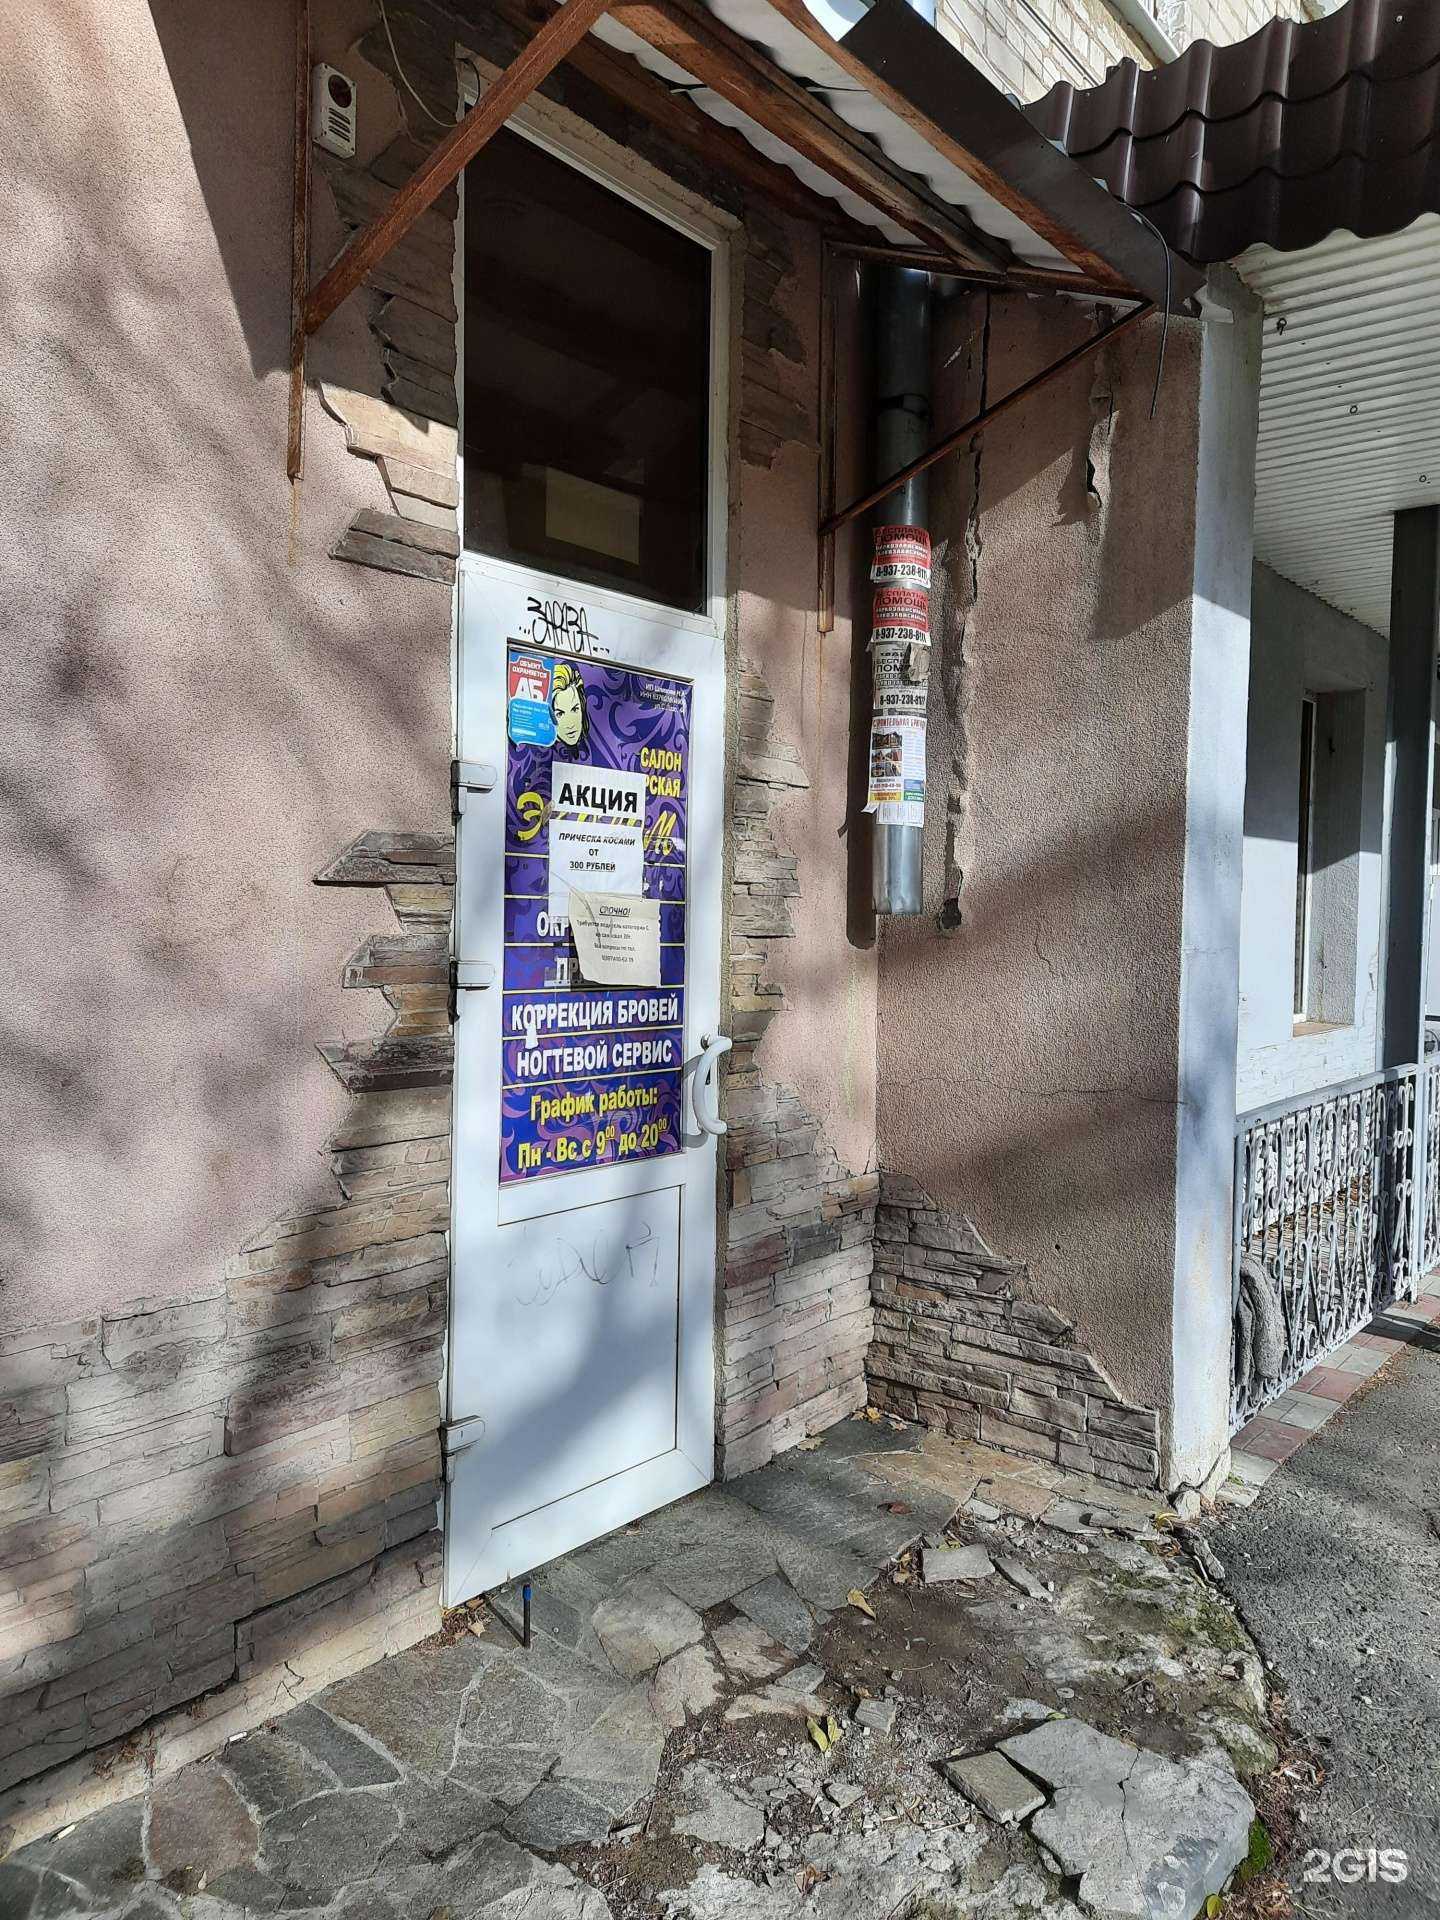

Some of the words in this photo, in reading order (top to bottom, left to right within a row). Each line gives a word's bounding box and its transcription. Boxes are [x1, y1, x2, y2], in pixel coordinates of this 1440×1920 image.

[641, 747, 682, 772] САЛОН
[558, 783, 638, 813] АКЦИЯ
[559, 832, 601, 843] ПРИЧЕСКА
[588, 848, 599, 856] ОТ
[569, 861, 584, 869] 300
[586, 861, 616, 871] РУБЛЕЙ
[599, 905, 630, 916] СРОЧНО!
[512, 1000, 613, 1031] КОРРЕКЦИЯ
[617, 992, 678, 1025] БРОВЕЙ
[517, 1040, 608, 1077] НОГТЕВОЙ
[612, 1040, 672, 1067] СЕРВИС
[530, 1091, 595, 1125] График
[599, 1084, 658, 1117] работы:
[518, 1143, 541, 1169] Пн
[556, 1137, 577, 1162] Вс
[618, 1132, 637, 1156] до
